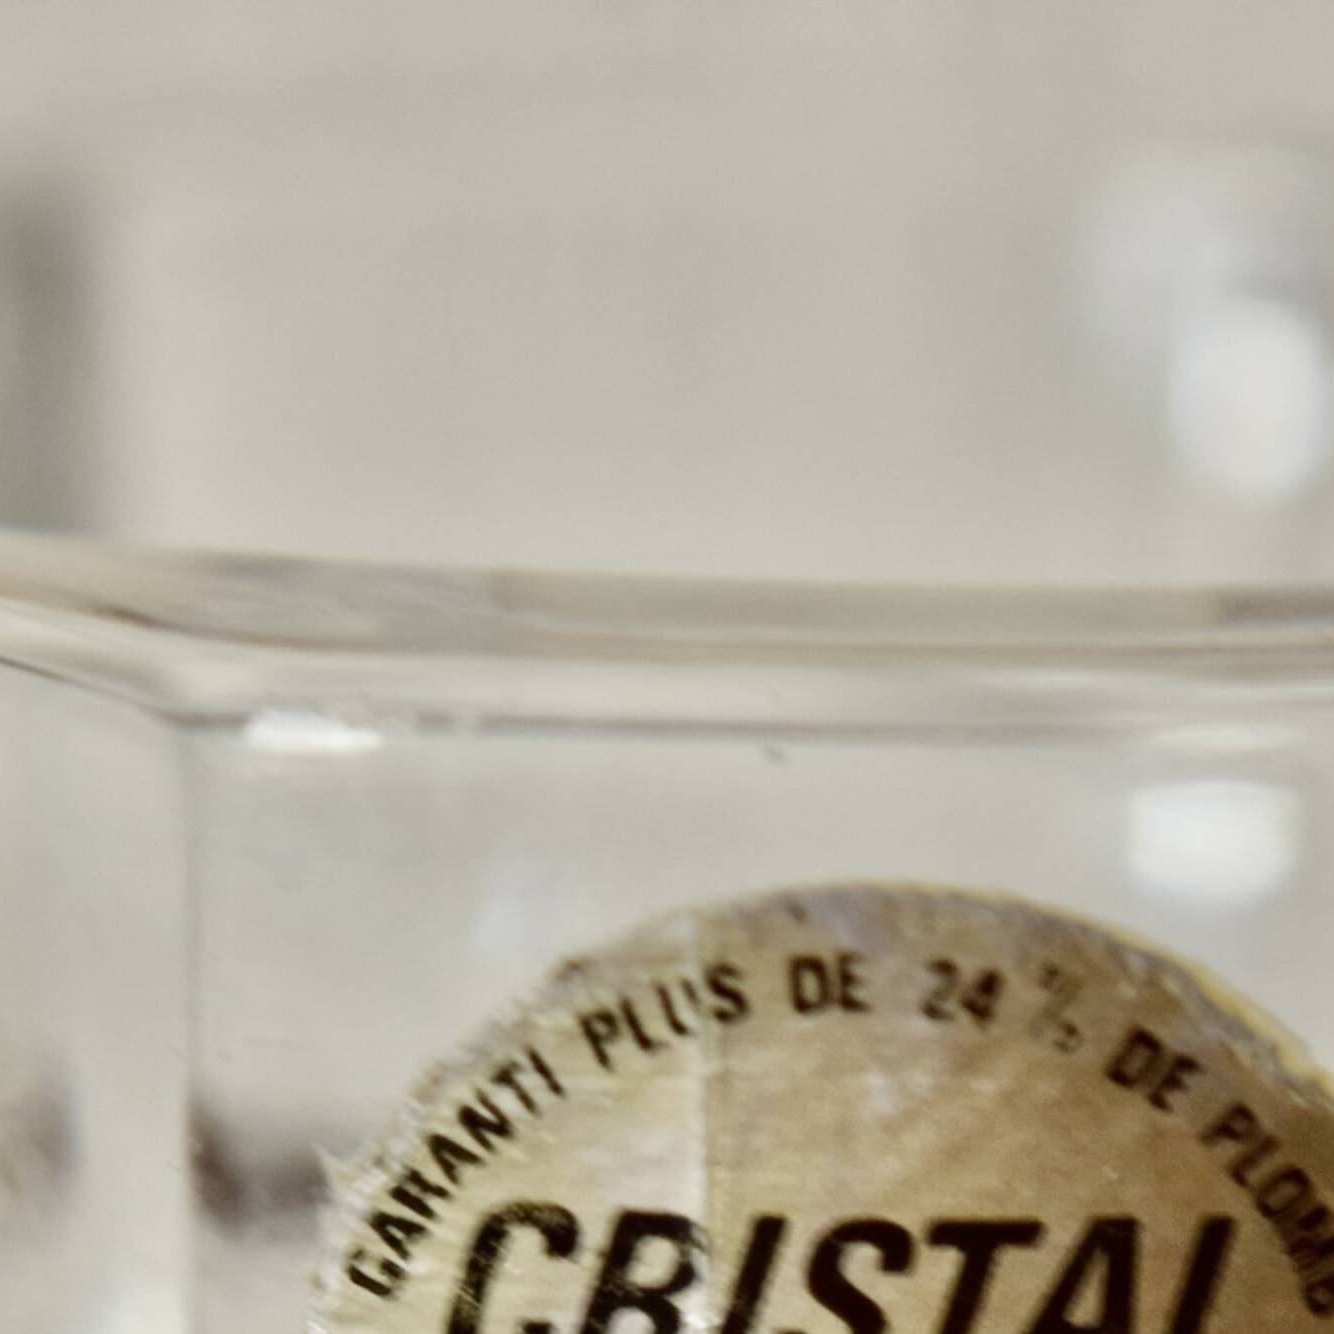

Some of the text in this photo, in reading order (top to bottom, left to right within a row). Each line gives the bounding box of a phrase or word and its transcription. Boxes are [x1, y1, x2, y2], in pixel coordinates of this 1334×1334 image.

[346, 1047, 565, 1301] GARANTI
[575, 962, 750, 1074] PLUS
[789, 950, 873, 1016] DE
[921, 958, 1006, 1026] 24
[1104, 1024, 1202, 1114] DE
